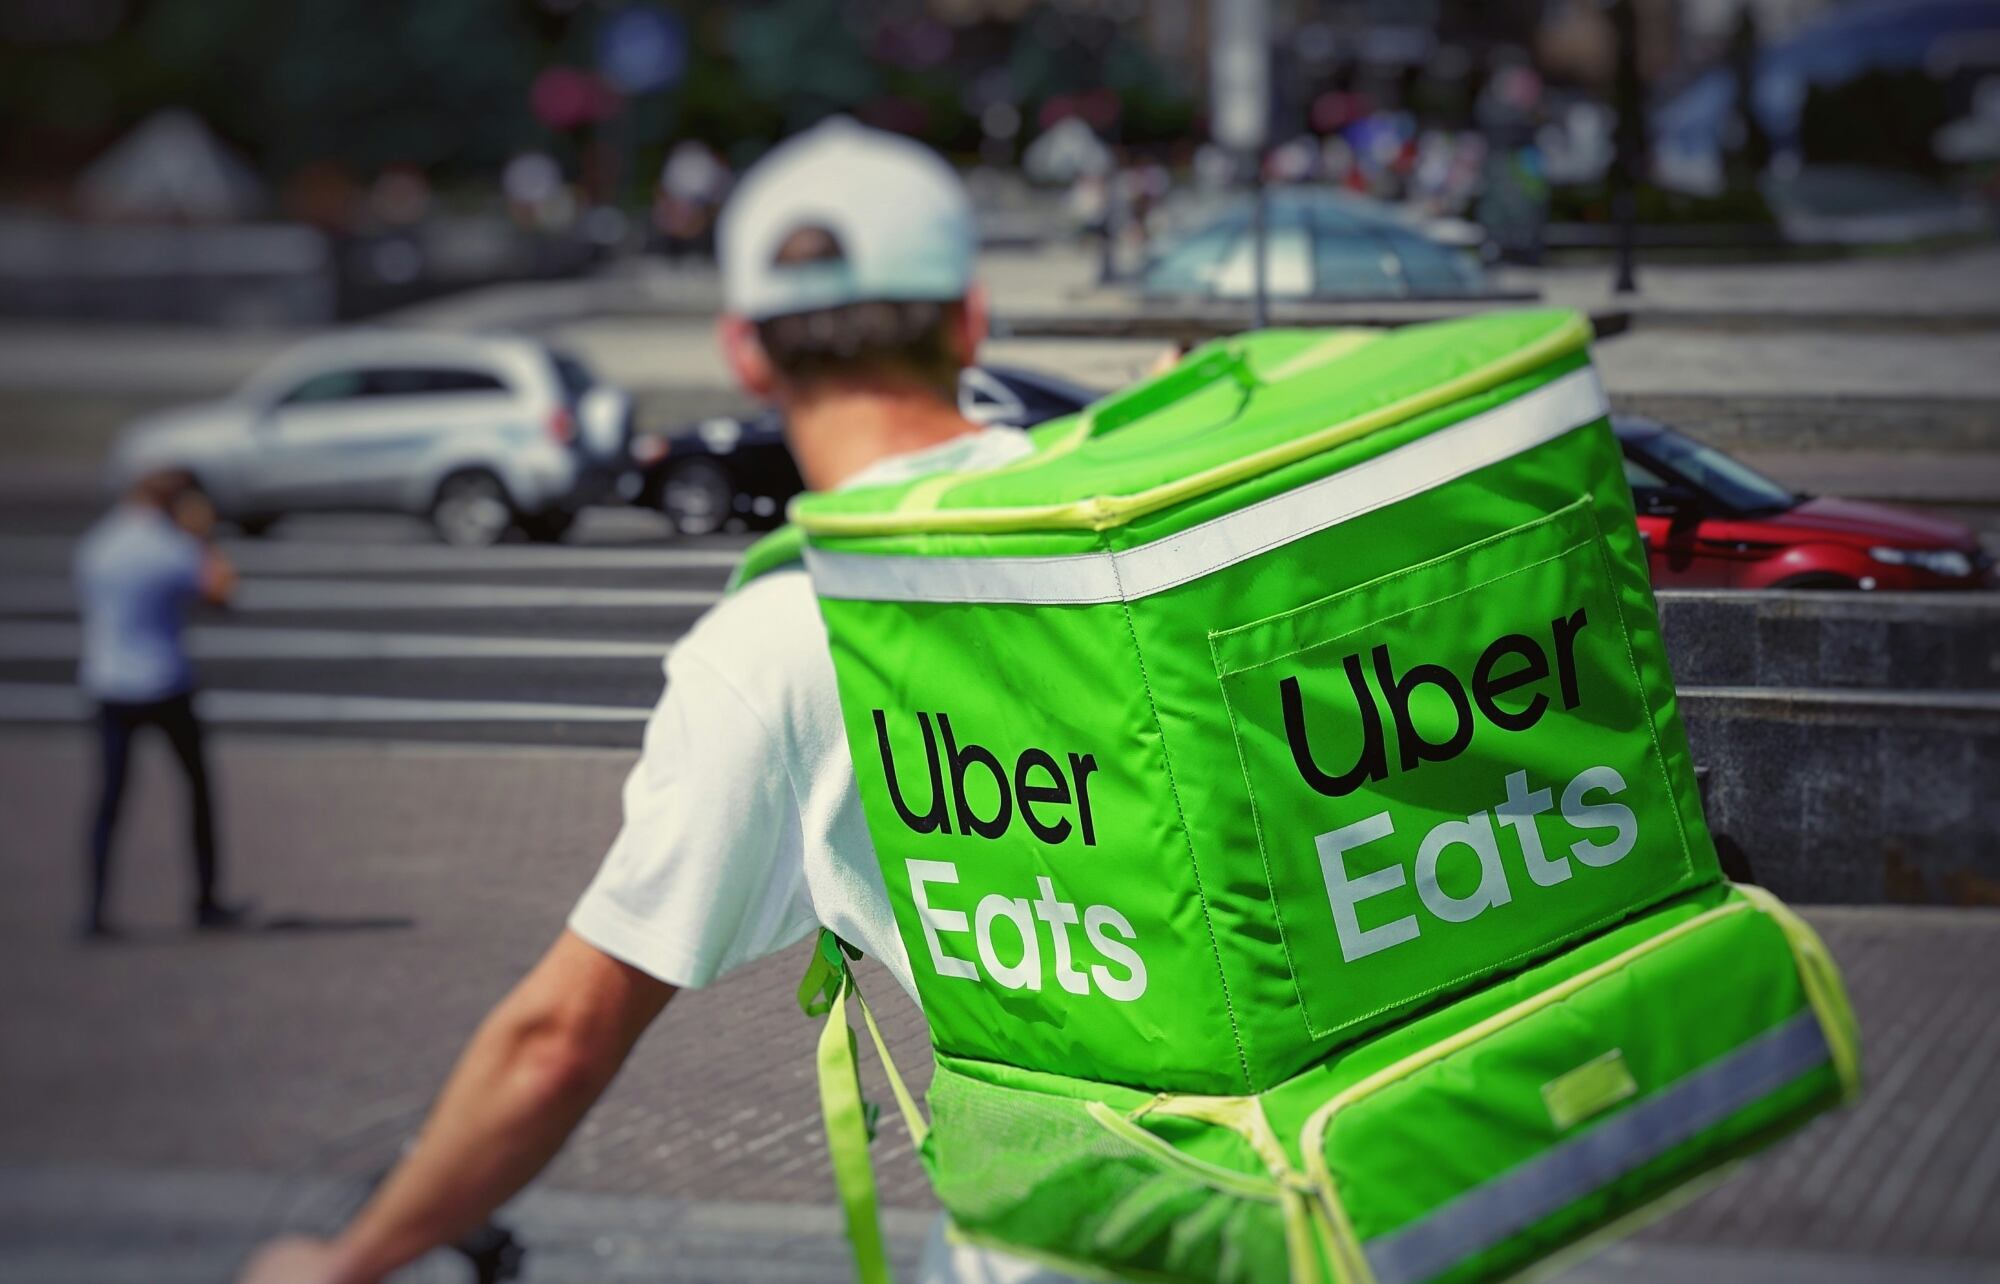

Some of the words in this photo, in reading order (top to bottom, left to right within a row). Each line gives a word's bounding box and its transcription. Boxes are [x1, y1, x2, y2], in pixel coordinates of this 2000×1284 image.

[873, 708, 1098, 846] Uber
[1280, 607, 1588, 798] Uber
[904, 857, 1147, 1002] Eats
[1314, 765, 1638, 964] Eats
